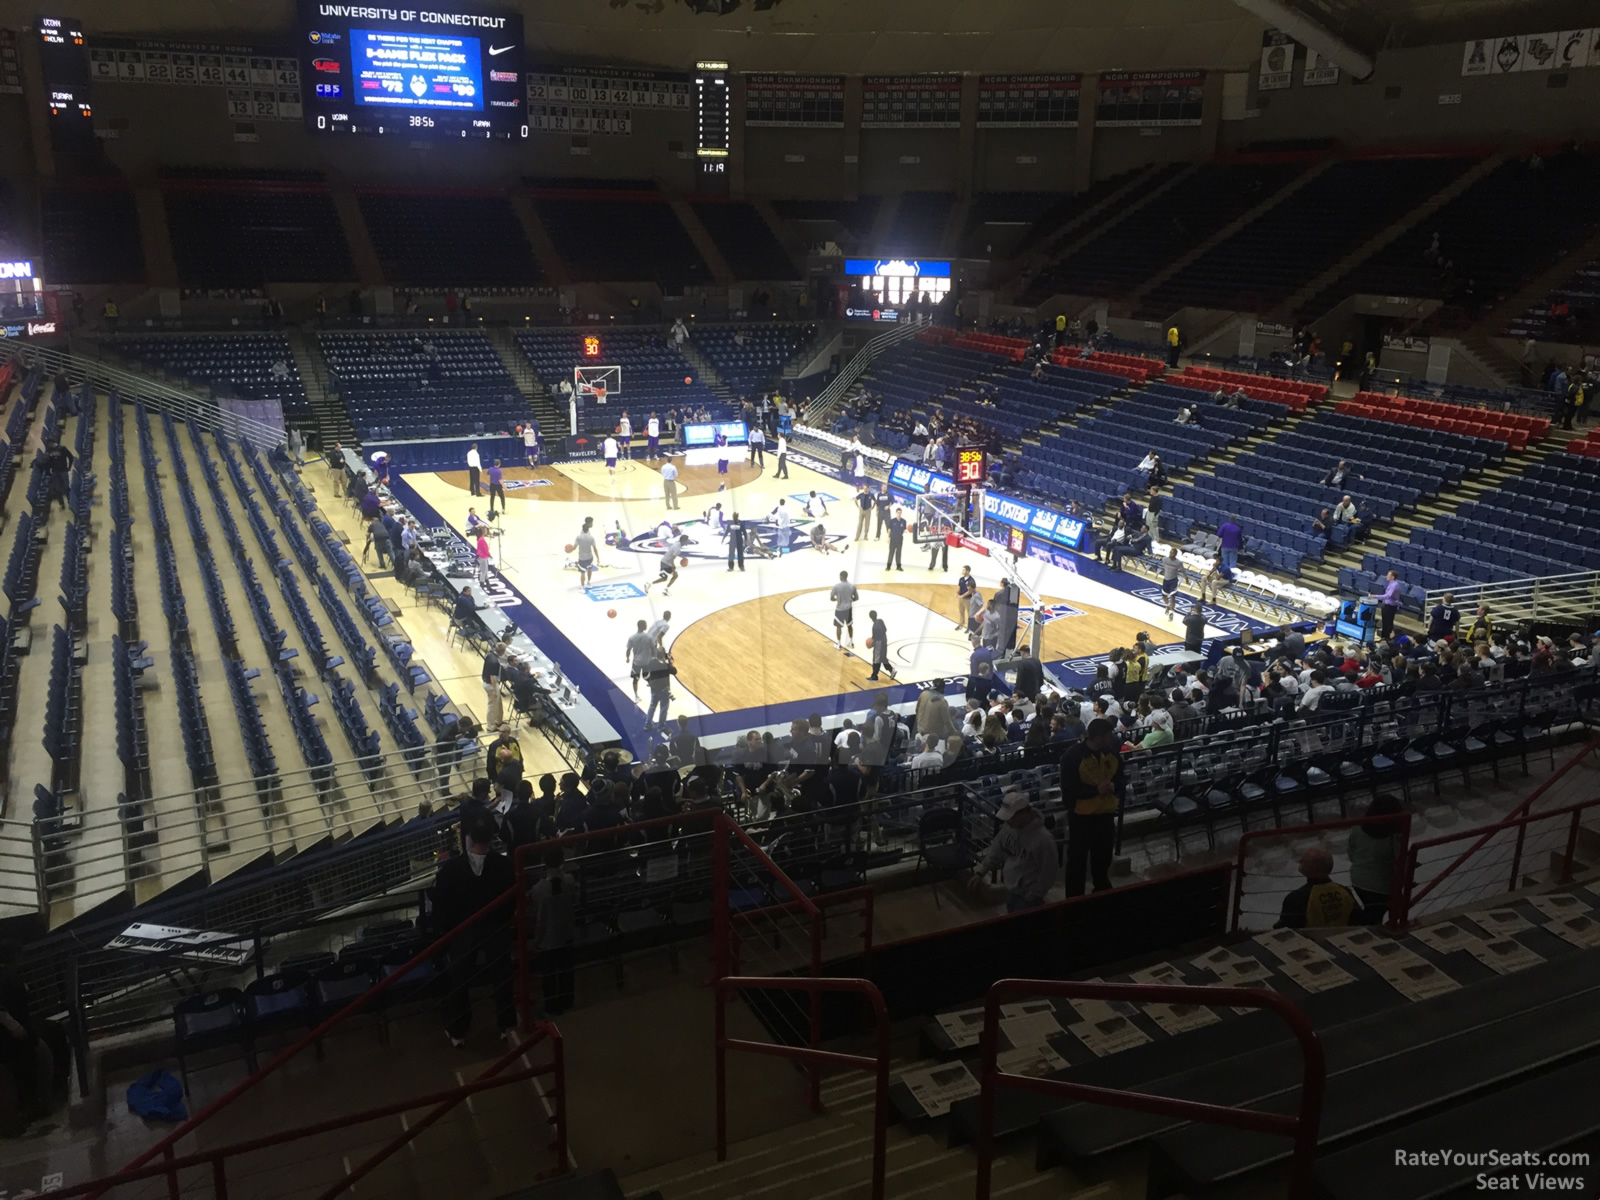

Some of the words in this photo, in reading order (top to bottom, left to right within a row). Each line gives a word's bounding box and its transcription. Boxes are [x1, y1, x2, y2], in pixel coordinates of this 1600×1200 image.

[319, 4, 399, 21] UNIVERSITY
[400, 10, 417, 21] OF
[420, 11, 506, 29] CONNECTICUT
[43, 18, 61, 27] UCONN
[169, 42, 206, 50] HUSKIES
[410, 50, 436, 62] FLEX
[438, 52, 466, 63] PACK
[1529, 39, 1555, 65] UCF
[128, 64, 135, 75] 9
[149, 65, 168, 78] 22
[176, 67, 195, 79] 25
[203, 68, 220, 80] 42
[228, 69, 246, 81] 44
[280, 72, 297, 84] 42
[1133, 72, 1200, 80] CHAMPIONSHIP
[316, 84, 340, 93] CBS
[530, 86, 544, 97] 52
[52, 92, 73, 100] FURMAN
[594, 90, 606, 101] 13
[614, 91, 628, 102] 42
[233, 102, 247, 113] 13
[258, 103, 273, 114] 22
[317, 116, 326, 129] 0
[521, 125, 528, 138] 0
[586, 345, 598, 355] 30
[960, 451, 982, 462] 38:56
[962, 462, 979, 481] 30
[998, 500, 1031, 524] SYSTEMS
[1443, 609, 1452, 620] 13
[1319, 891, 1342, 904] CSC
